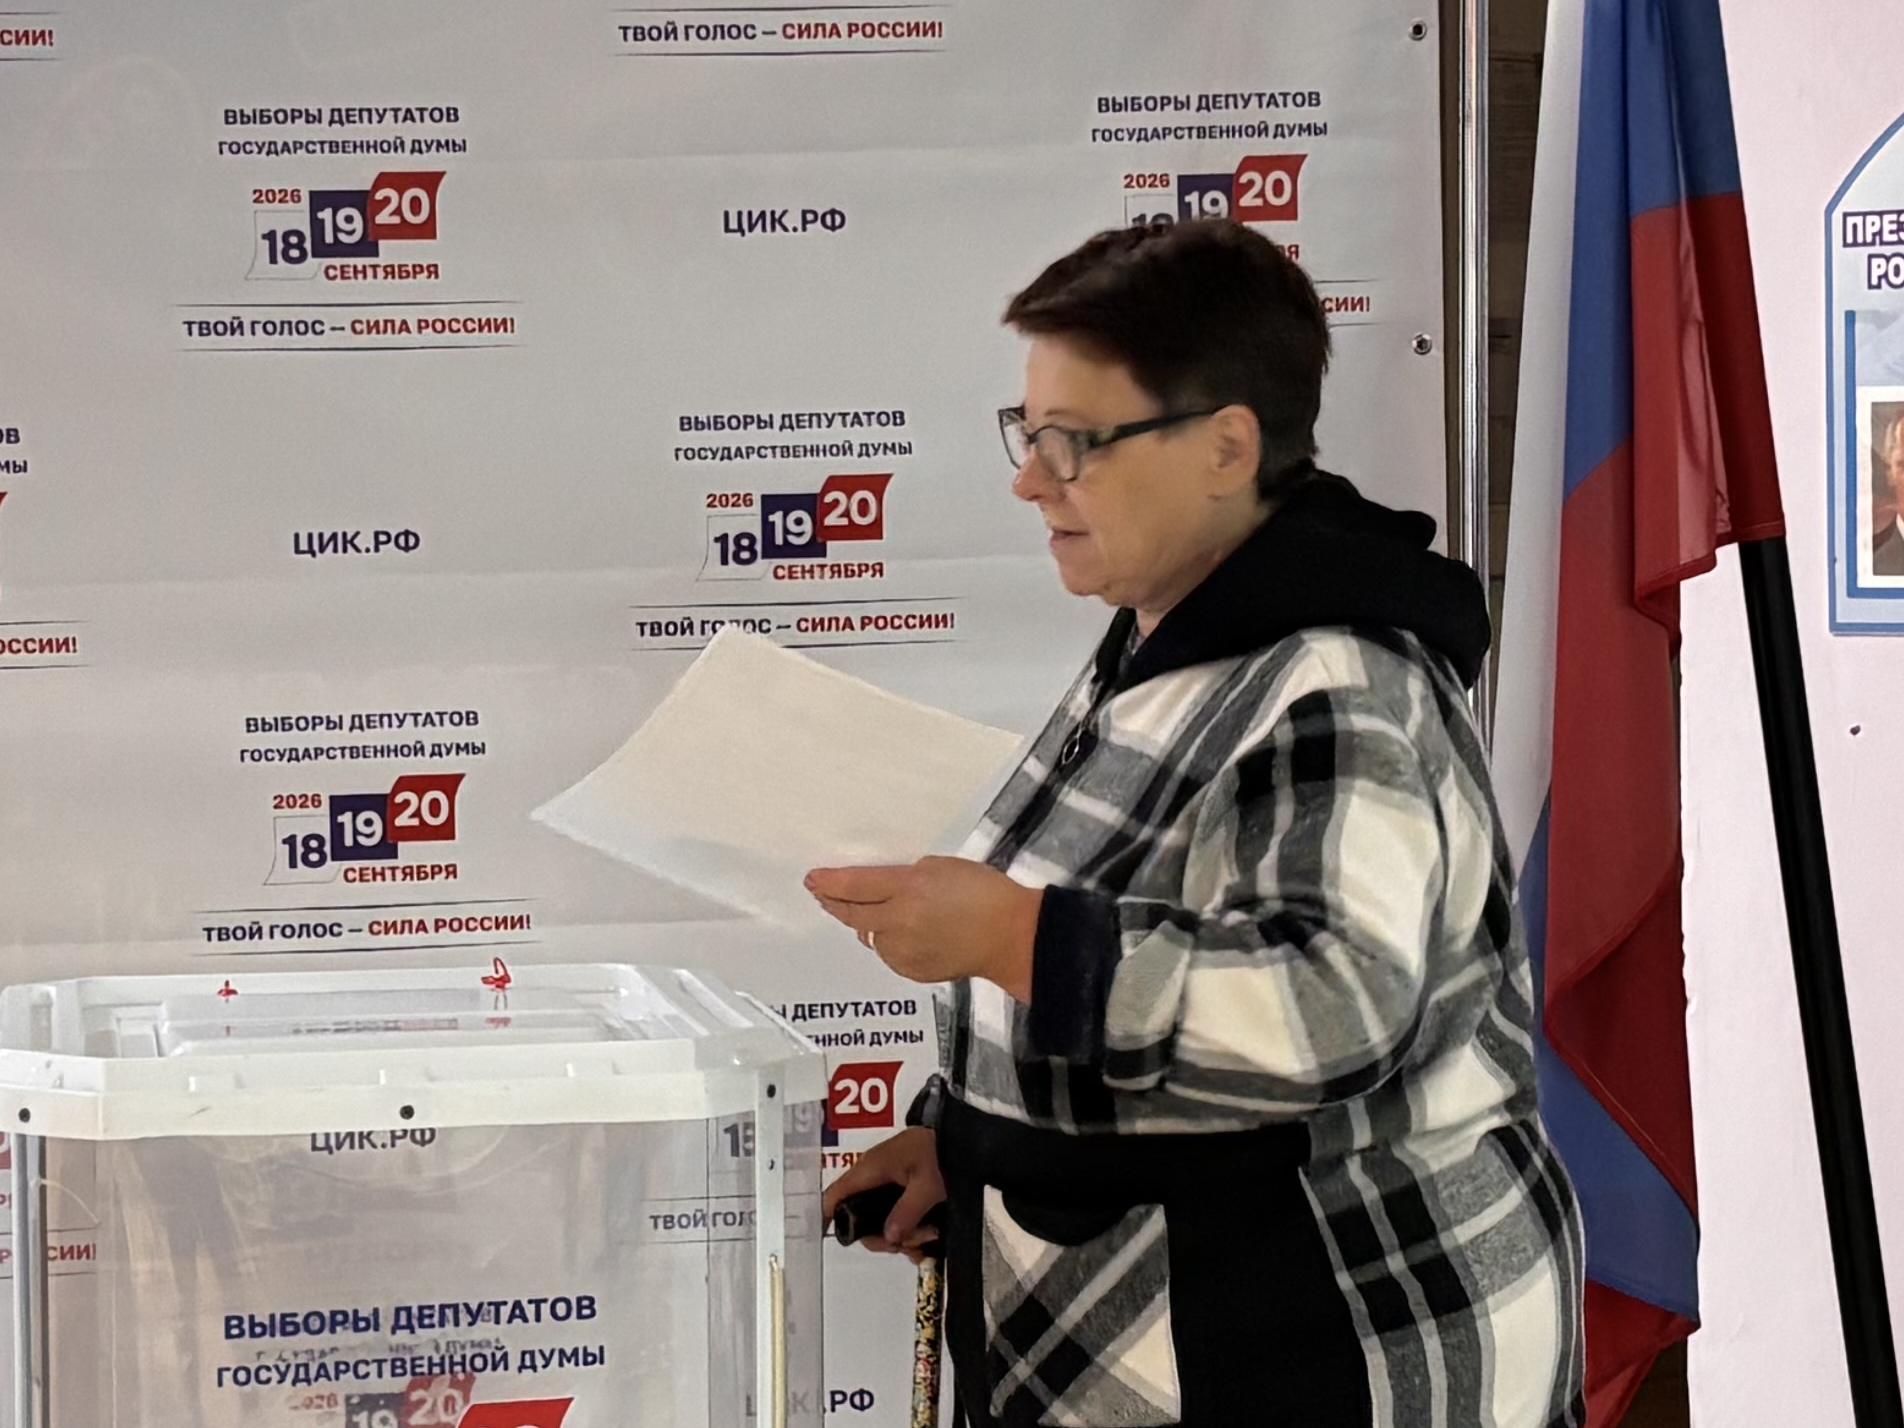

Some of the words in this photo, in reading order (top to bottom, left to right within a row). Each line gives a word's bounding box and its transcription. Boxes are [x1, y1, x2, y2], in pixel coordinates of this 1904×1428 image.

[616, 21, 677, 42] ТВОЙ
[683, 25, 756, 40] ГОЛОС
[781, 23, 841, 40] СИЛА
[848, 22, 945, 38] РОССИИ!
[224, 109, 322, 125] ВЫБОРЫ
[328, 107, 458, 126] ДЕПУТАТОВ
[218, 138, 405, 156] ГОСУДАРСТВЕННОЙ
[409, 139, 466, 156] ДУМЫ
[252, 188, 302, 204] 2026
[374, 188, 431, 224] 20
[317, 207, 363, 244] 19
[724, 208, 846, 237] ЦИК.РФ
[262, 229, 309, 265] 18
[324, 263, 440, 280] СЕНТЯБРЯ
[181, 317, 243, 338] ТВОЙ
[250, 321, 324, 336] ГОЛОС
[349, 319, 411, 335] СИЛА
[418, 317, 517, 334] РОССИИ!
[680, 415, 775, 432] ВЫБОРЫ
[780, 412, 906, 432] ДЕПУТАТОВ
[674, 442, 853, 462] ГОСУДАРСТВЕННОЙ
[857, 442, 912, 459] ДУМЫ
[705, 492, 754, 508] 2026
[822, 489, 877, 525] 20
[767, 509, 812, 545] 19
[294, 529, 420, 558] ЦИК.РФ
[713, 531, 759, 566] 18
[772, 562, 885, 581] СЕНТЯБРЯ
[634, 617, 694, 638] ТВОЙ
[796, 617, 856, 633] СИЛА
[862, 613, 957, 631] РОССИИ!
[246, 715, 343, 734] ВЫБОРЫ
[349, 710, 478, 732] ДЕПУТАТОВ
[240, 741, 425, 764] ГОСУДАРСТВЕННОЙ
[429, 741, 485, 759] ДУМЫ
[273, 793, 322, 810] 2026
[393, 790, 450, 826] 20
[336, 811, 383, 848] 19
[282, 833, 329, 869] 18
[343, 863, 458, 883] СЕНТЯБРЯ
[201, 921, 262, 943] ТВОЙ
[269, 923, 342, 940] ГОЛОС
[367, 919, 429, 937] СИЛА
[435, 915, 533, 933] РОССИИ!
[224, 1305, 381, 1341] ВЫБОРЫ
[390, 1295, 597, 1335] ДЕПУТАТОВ
[217, 1348, 510, 1389] ГОСУДАРСТВЕННОЙ
[517, 1344, 607, 1373] ДУМЫ
